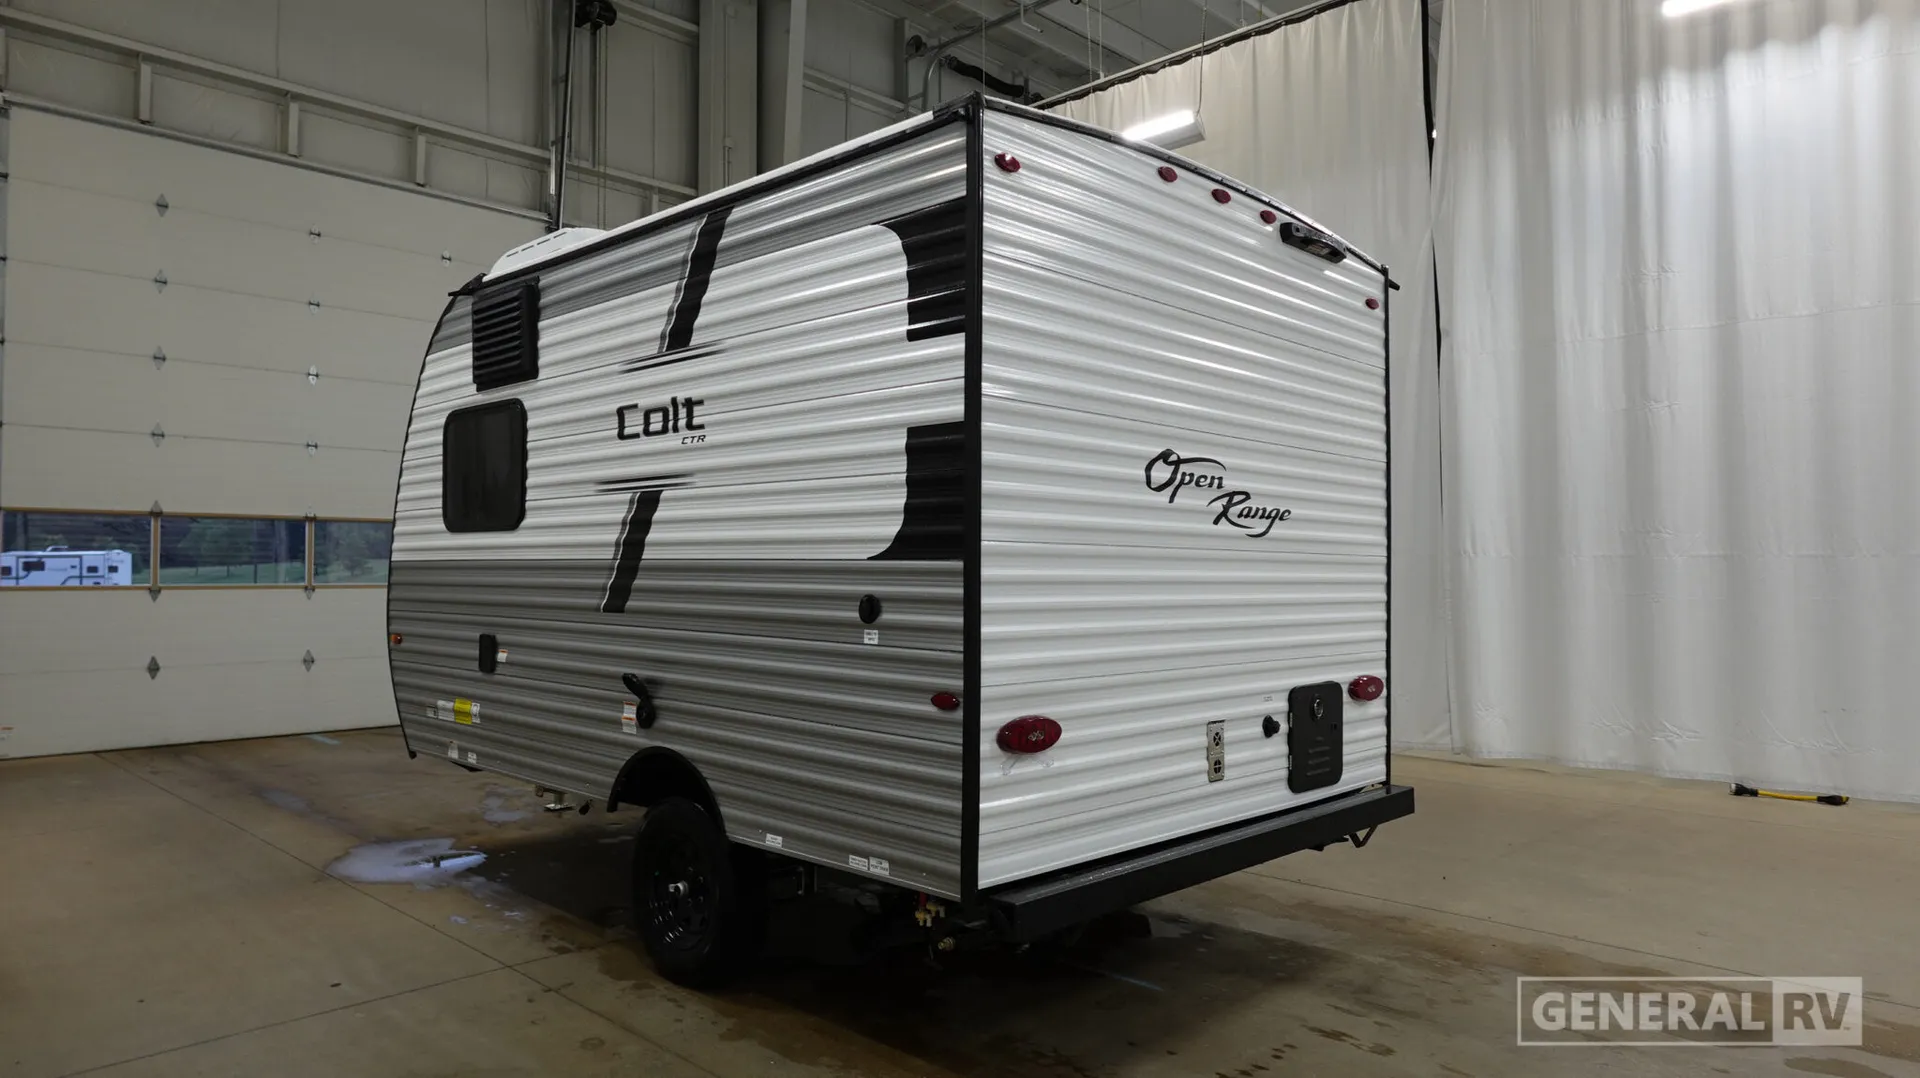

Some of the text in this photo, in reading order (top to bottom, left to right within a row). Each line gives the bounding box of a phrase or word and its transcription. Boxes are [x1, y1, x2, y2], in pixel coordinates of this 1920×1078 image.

[616, 396, 705, 440] Colt
[681, 434, 706, 445] CTR
[1145, 449, 1227, 503] Open
[1206, 491, 1291, 538] Range
